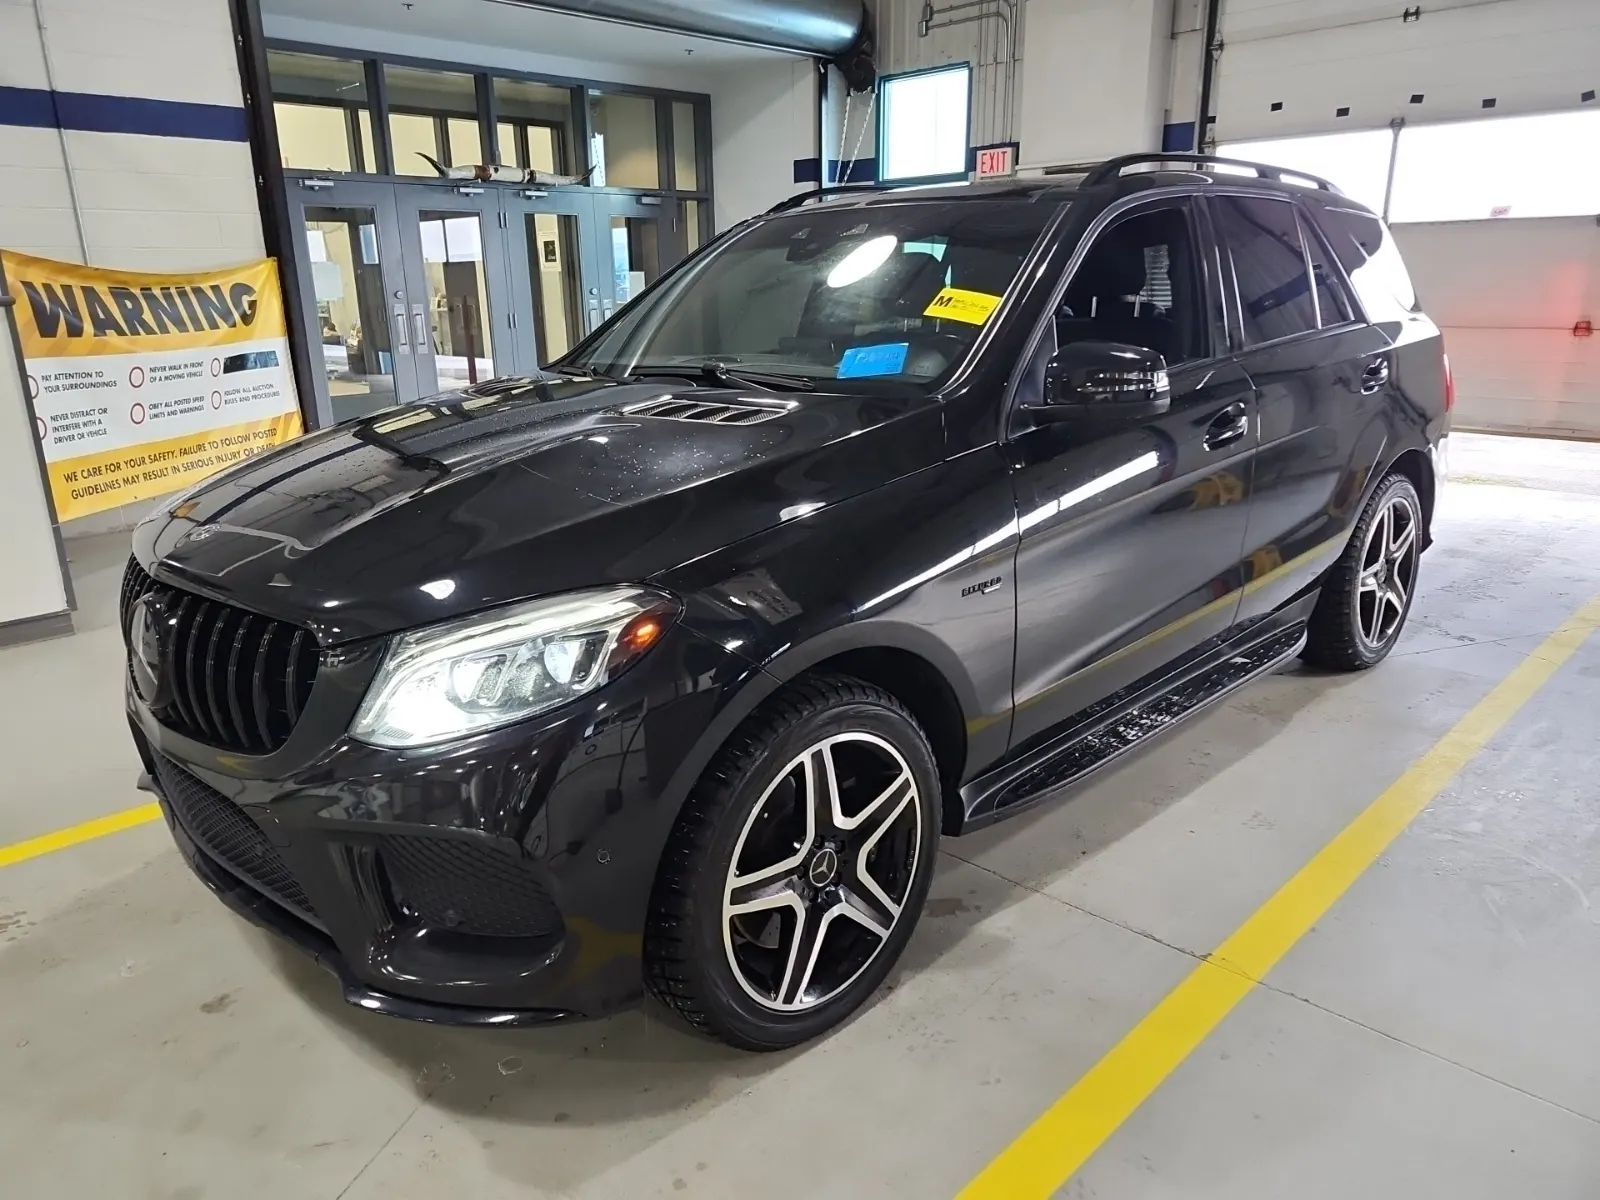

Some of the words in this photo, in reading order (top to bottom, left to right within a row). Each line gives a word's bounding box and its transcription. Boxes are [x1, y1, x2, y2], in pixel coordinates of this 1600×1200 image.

[981, 151, 1007, 174] EXIT
[933, 296, 954, 307] M
[20, 280, 257, 338] WARNING
[54, 372, 92, 380] ATTENTION
[164, 373, 185, 381] MOVING
[44, 385, 60, 393] YOUR
[62, 380, 117, 391] SURROUNDINGS
[174, 398, 191, 407] POSTED
[50, 413, 69, 422] NEVER
[70, 409, 96, 419] DISTRACT
[149, 412, 165, 420] LIMITS
[179, 405, 204, 414] WARNINGS
[52, 422, 80, 433] INTERFERE
[54, 434, 75, 444] DRIVER
[86, 428, 107, 437] VEHICLE
[63, 471, 78, 483] WE
[81, 466, 102, 479] CARE
[105, 462, 122, 474] FOR
[123, 456, 147, 469] YOUR
[149, 450, 177, 464] SAFETY.
[180, 443, 207, 457] FAILURE
[208, 440, 218, 450] TO
[220, 434, 250, 447] FOLLOW
[253, 428, 277, 440] POSTED
[71, 478, 121, 500] GUIDELINES
[122, 474, 141, 487] MAY
[142, 467, 169, 482] RESULT
[171, 465, 180, 474] IN
[183, 457, 214, 472] SERIOUS
[216, 451, 241, 463] INJURY
[244, 448, 255, 457] OR
